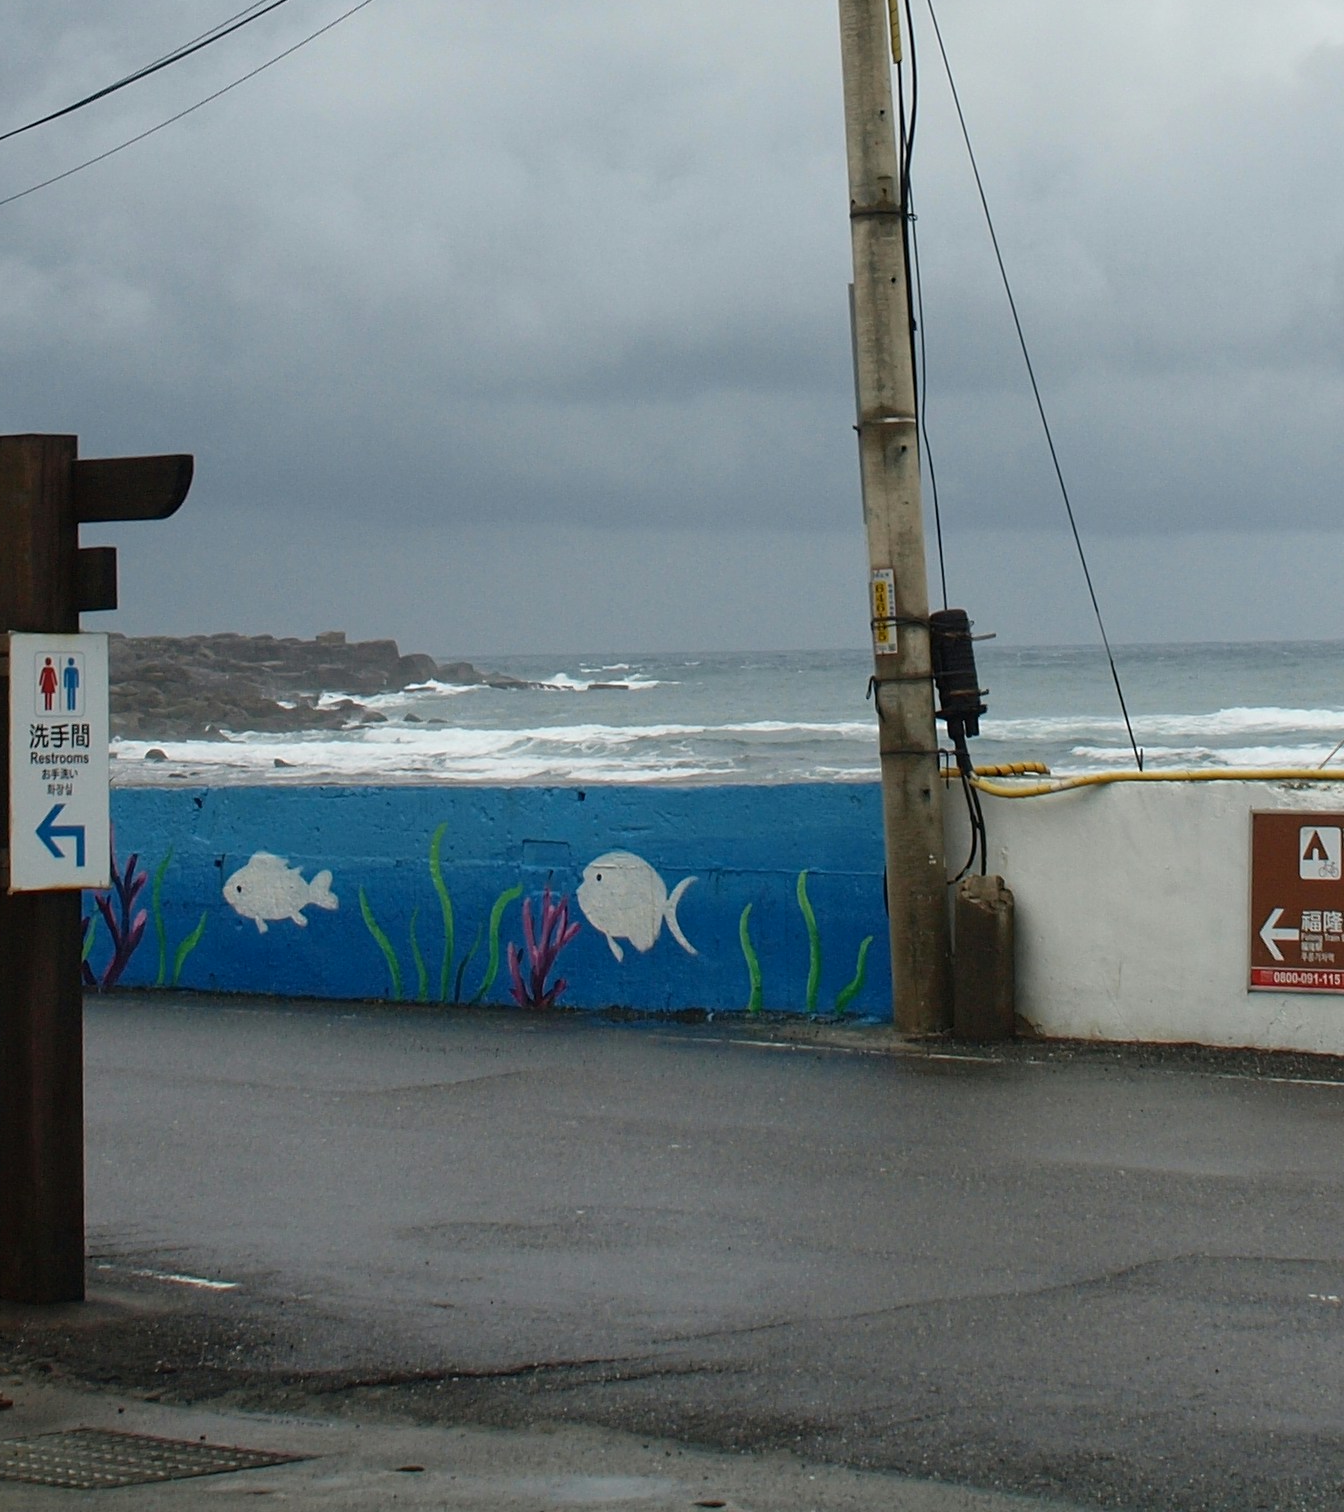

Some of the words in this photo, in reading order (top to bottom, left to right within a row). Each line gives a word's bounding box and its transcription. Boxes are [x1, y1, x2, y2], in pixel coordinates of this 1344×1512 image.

[29, 723, 90, 749] 洗手間
[30, 751, 90, 765] Restrooms
[1273, 971, 1341, 985] 0800-091-115
